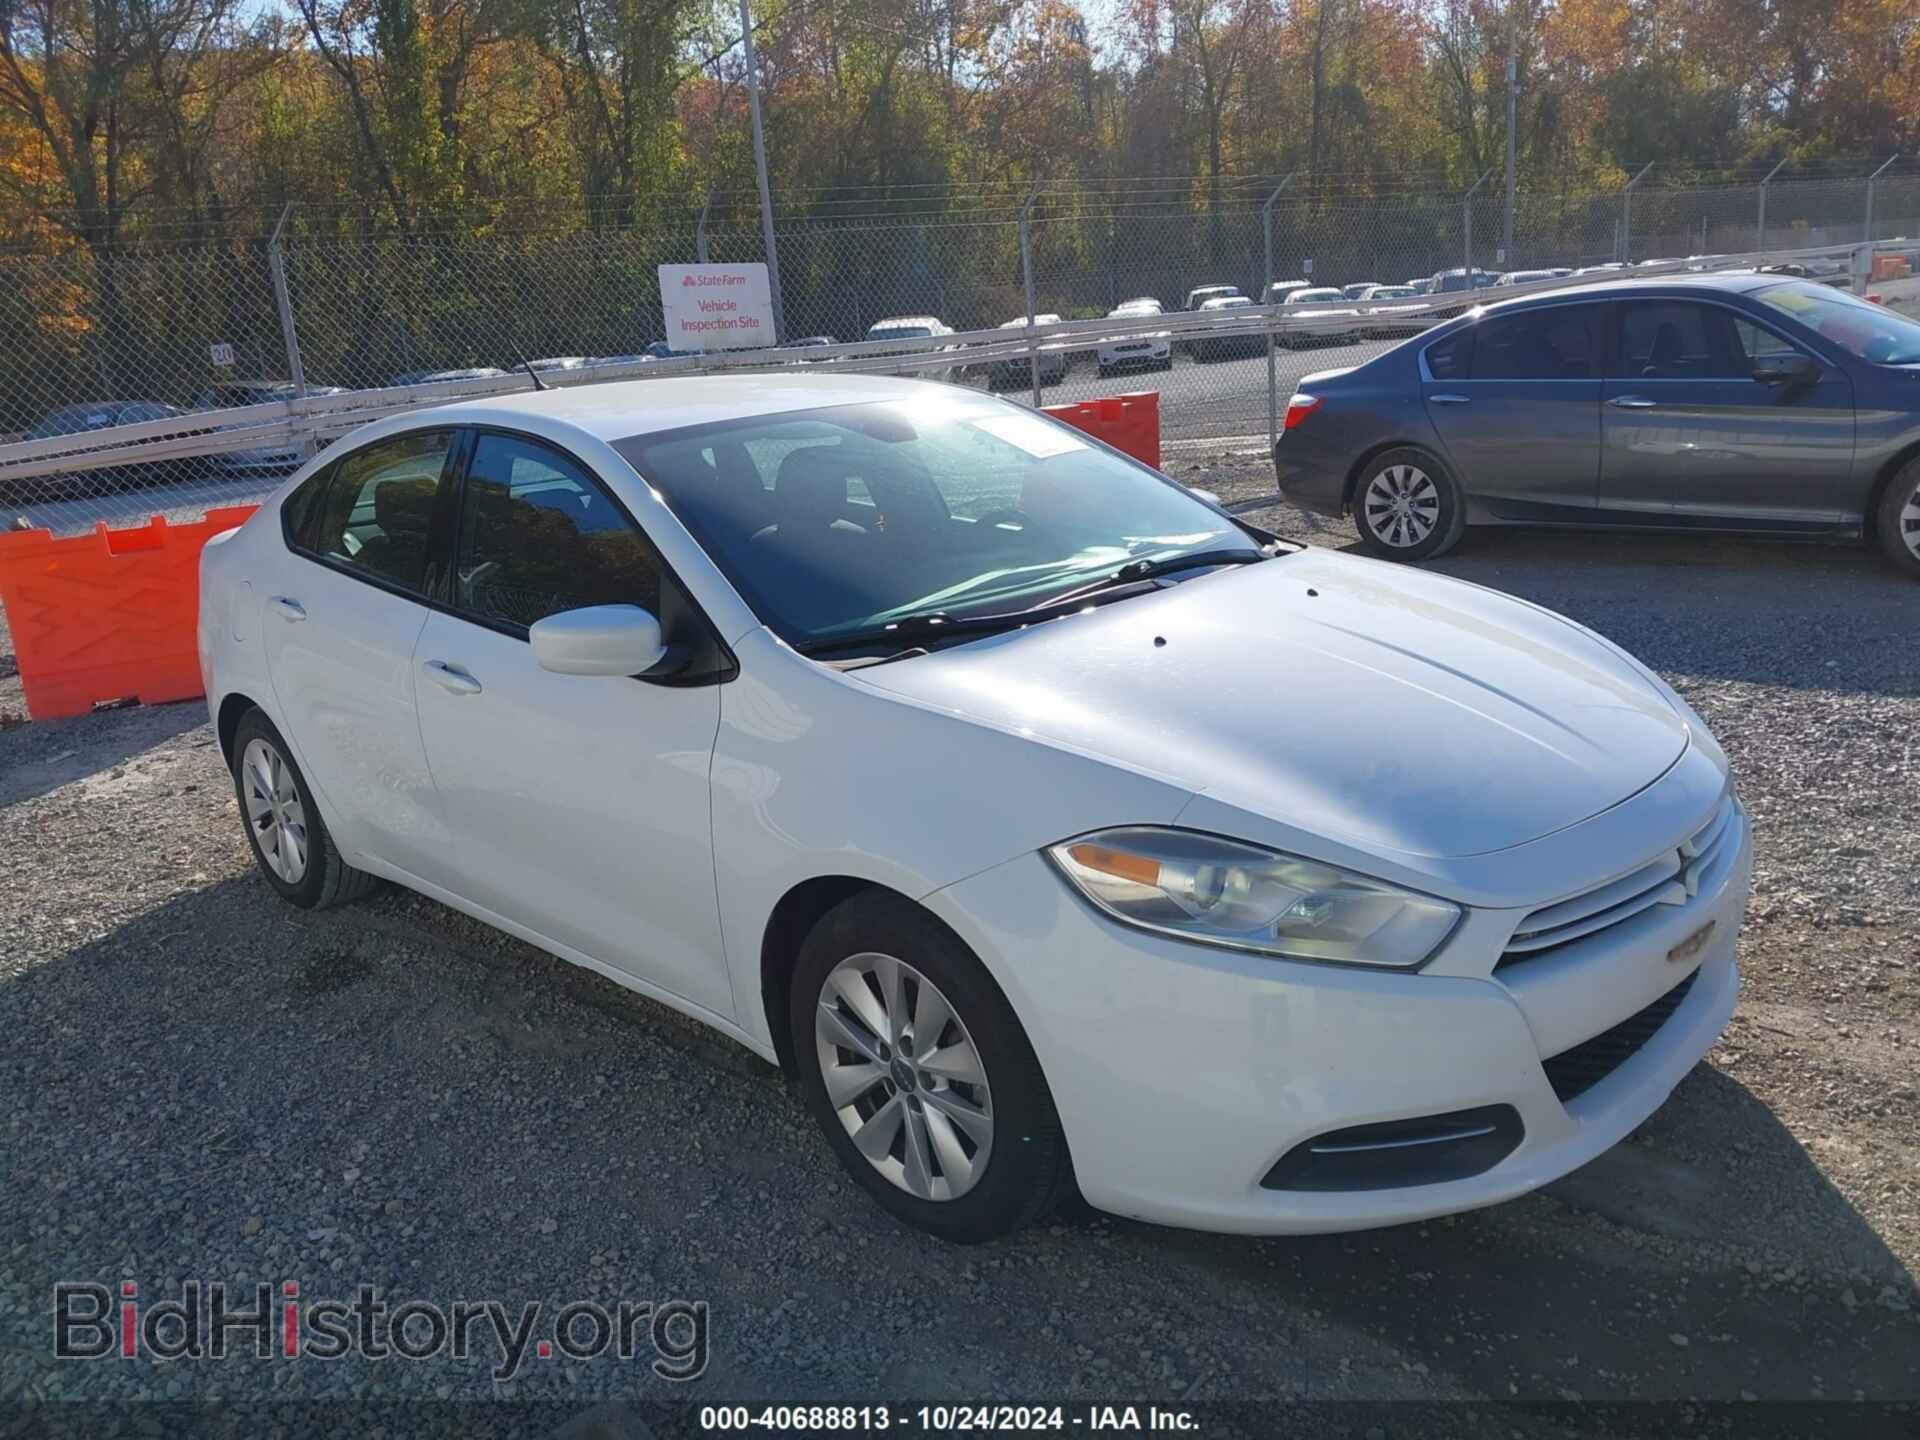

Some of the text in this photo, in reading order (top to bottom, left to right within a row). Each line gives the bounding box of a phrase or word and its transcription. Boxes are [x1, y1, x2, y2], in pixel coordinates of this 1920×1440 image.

[698, 300, 737, 312] Vehicle
[681, 315, 760, 333] Inspection Site
